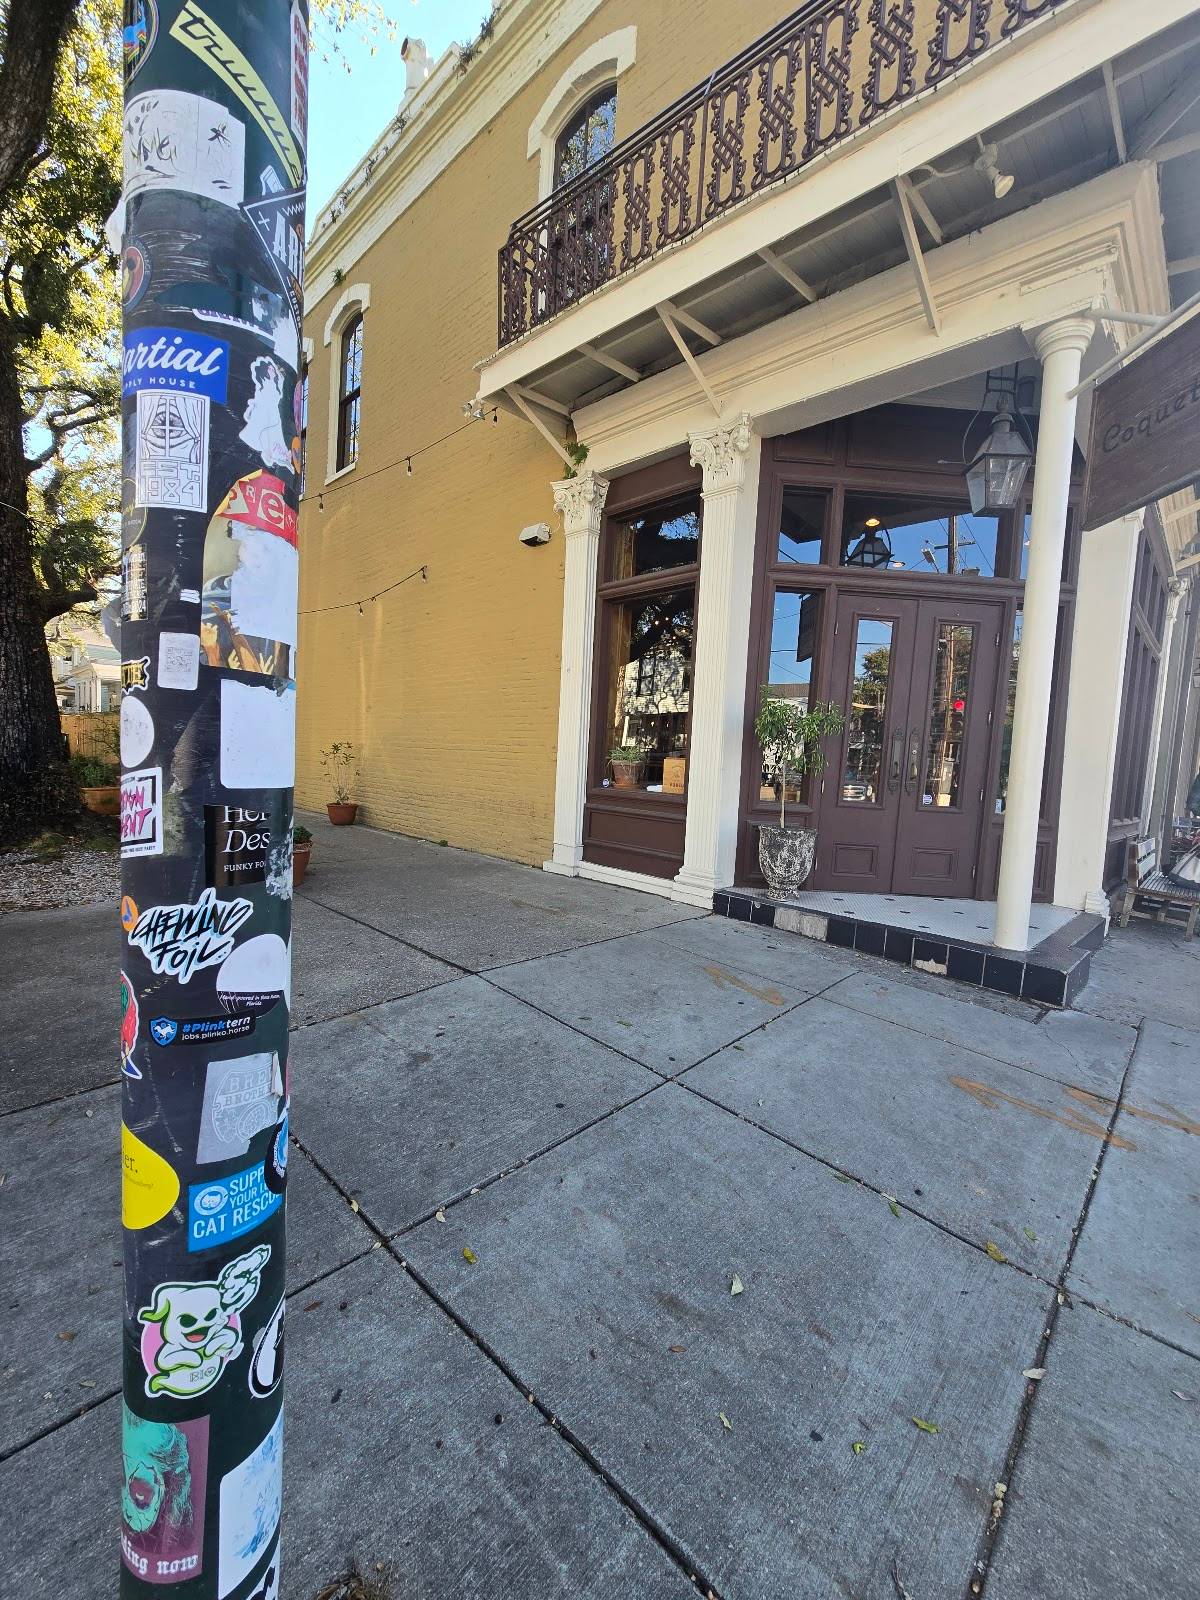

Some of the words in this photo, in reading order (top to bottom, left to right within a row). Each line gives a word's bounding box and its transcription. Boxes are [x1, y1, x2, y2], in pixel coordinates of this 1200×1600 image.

[121, 336, 223, 376] artial
[149, 376, 195, 389] HOUSE
[139, 477, 201, 507] 1984
[223, 862, 254, 872] FUNKY
[255, 860, 267, 869] FO
[132, 891, 251, 947] CHEWING
[181, 1025, 250, 1041] jobs.plinko.horse
[182, 1016, 251, 1033] #Plinktern
[229, 1067, 271, 1090] BRE
[229, 1165, 265, 1196] SUPP
[229, 1186, 257, 1209] YOUR
[193, 1213, 228, 1239] CAT
[156, 1554, 199, 1575] now
